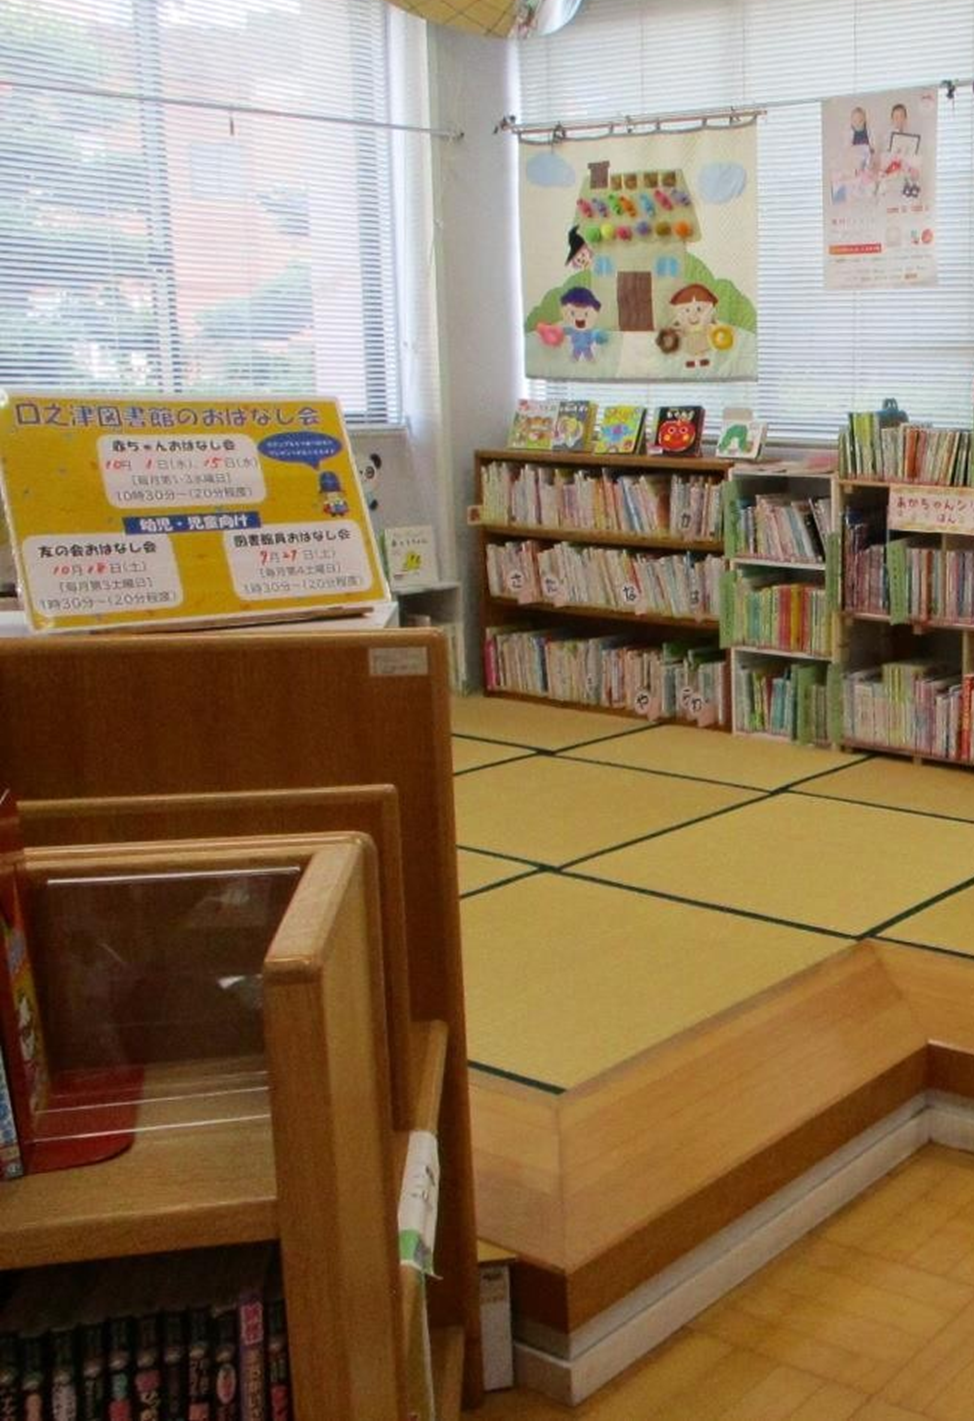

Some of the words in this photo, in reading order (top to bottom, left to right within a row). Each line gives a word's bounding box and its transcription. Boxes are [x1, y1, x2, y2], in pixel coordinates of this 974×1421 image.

[16, 403, 321, 428] 口之津図書館のおはなし会
[140, 514, 249, 532] 幼児・児童向け
[38, 541, 157, 558] 友の会おはなし会
[623, 585, 637, 602] な
